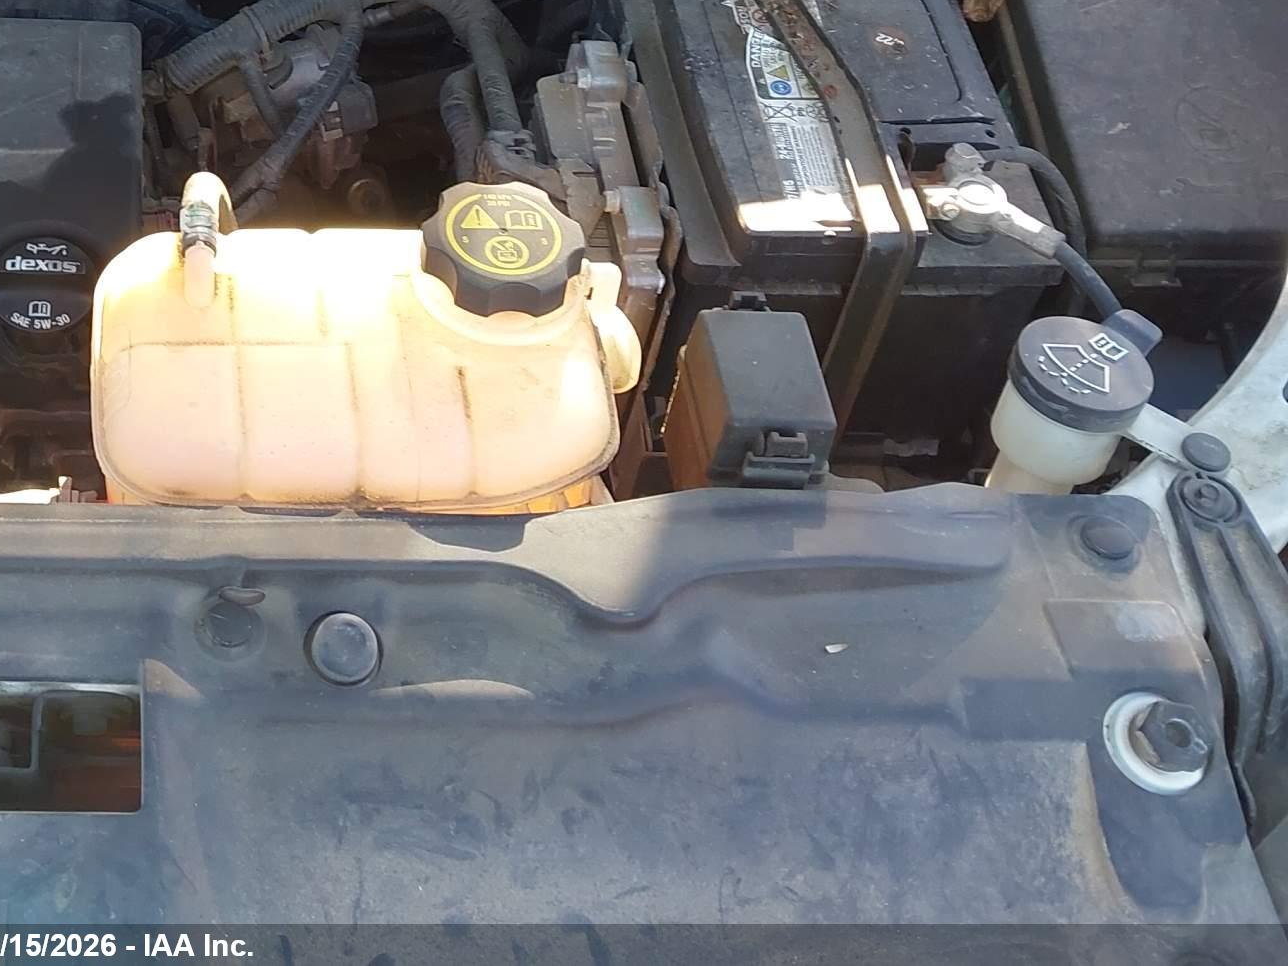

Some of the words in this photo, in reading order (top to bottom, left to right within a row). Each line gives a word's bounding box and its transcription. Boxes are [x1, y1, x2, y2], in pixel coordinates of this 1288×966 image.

[6, 255, 80, 273] dexos
[10, 312, 32, 328] SAE
[33, 314, 70, 329] 5W-30
